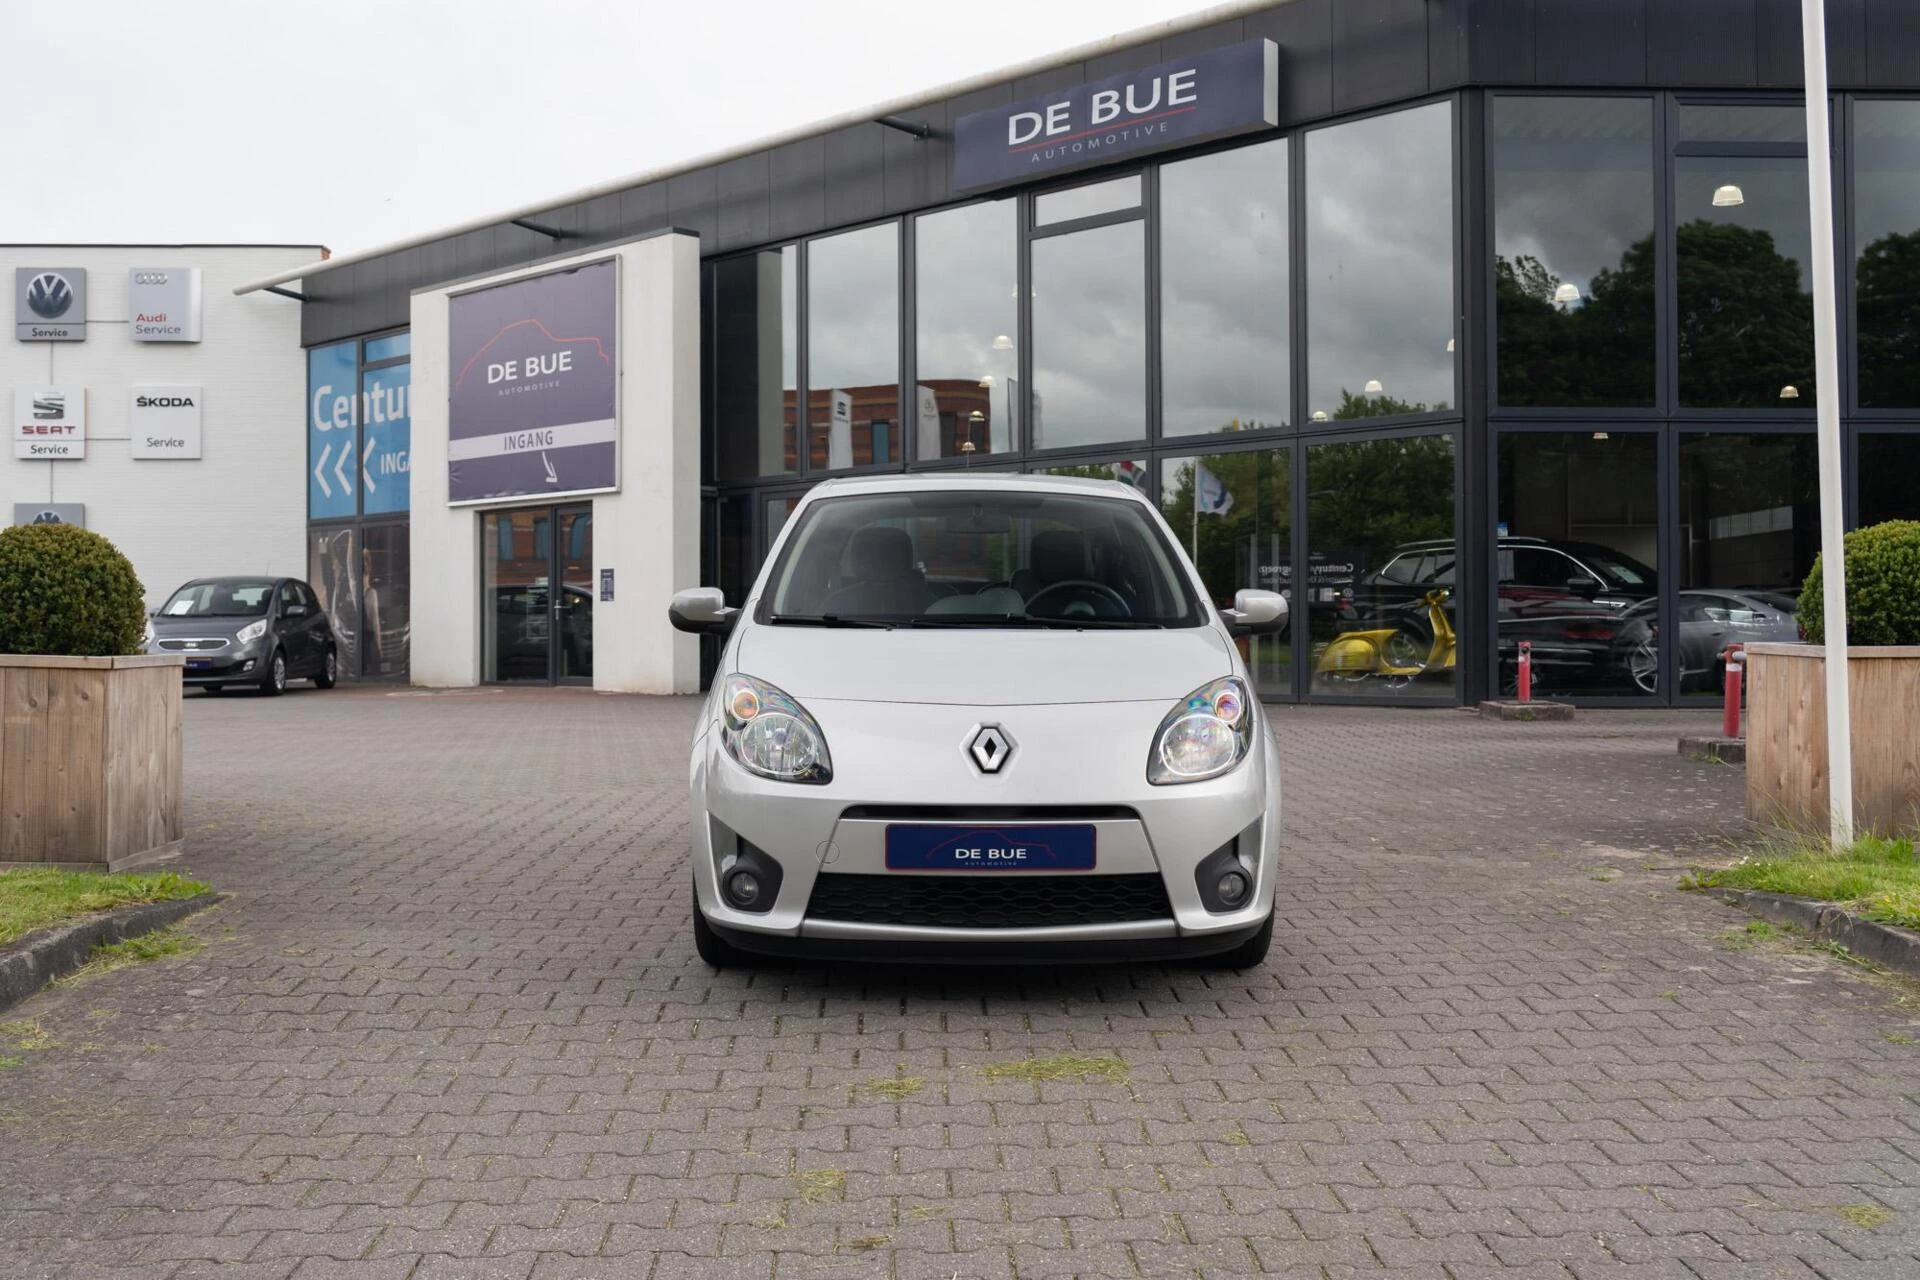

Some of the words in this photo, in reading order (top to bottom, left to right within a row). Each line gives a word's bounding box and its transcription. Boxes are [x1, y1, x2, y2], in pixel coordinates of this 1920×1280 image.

[1008, 100, 1071, 146] DE
[1091, 68, 1197, 125] BUE
[1031, 121, 1168, 163] AUTOMOTIVE
[136, 313, 167, 322] Audi
[32, 327, 69, 337] Service
[135, 324, 182, 335] Service
[488, 360, 518, 384] DE
[525, 350, 572, 377] BUE
[498, 380, 560, 396] AUTOMOTIVE
[136, 395, 194, 407] ŠKODA
[22, 425, 76, 435] SEAT
[146, 437, 185, 448] Service
[503, 430, 554, 451] INGANG
[30, 444, 69, 455] Service
[955, 848, 982, 859] DE
[988, 848, 1027, 859] BUE
